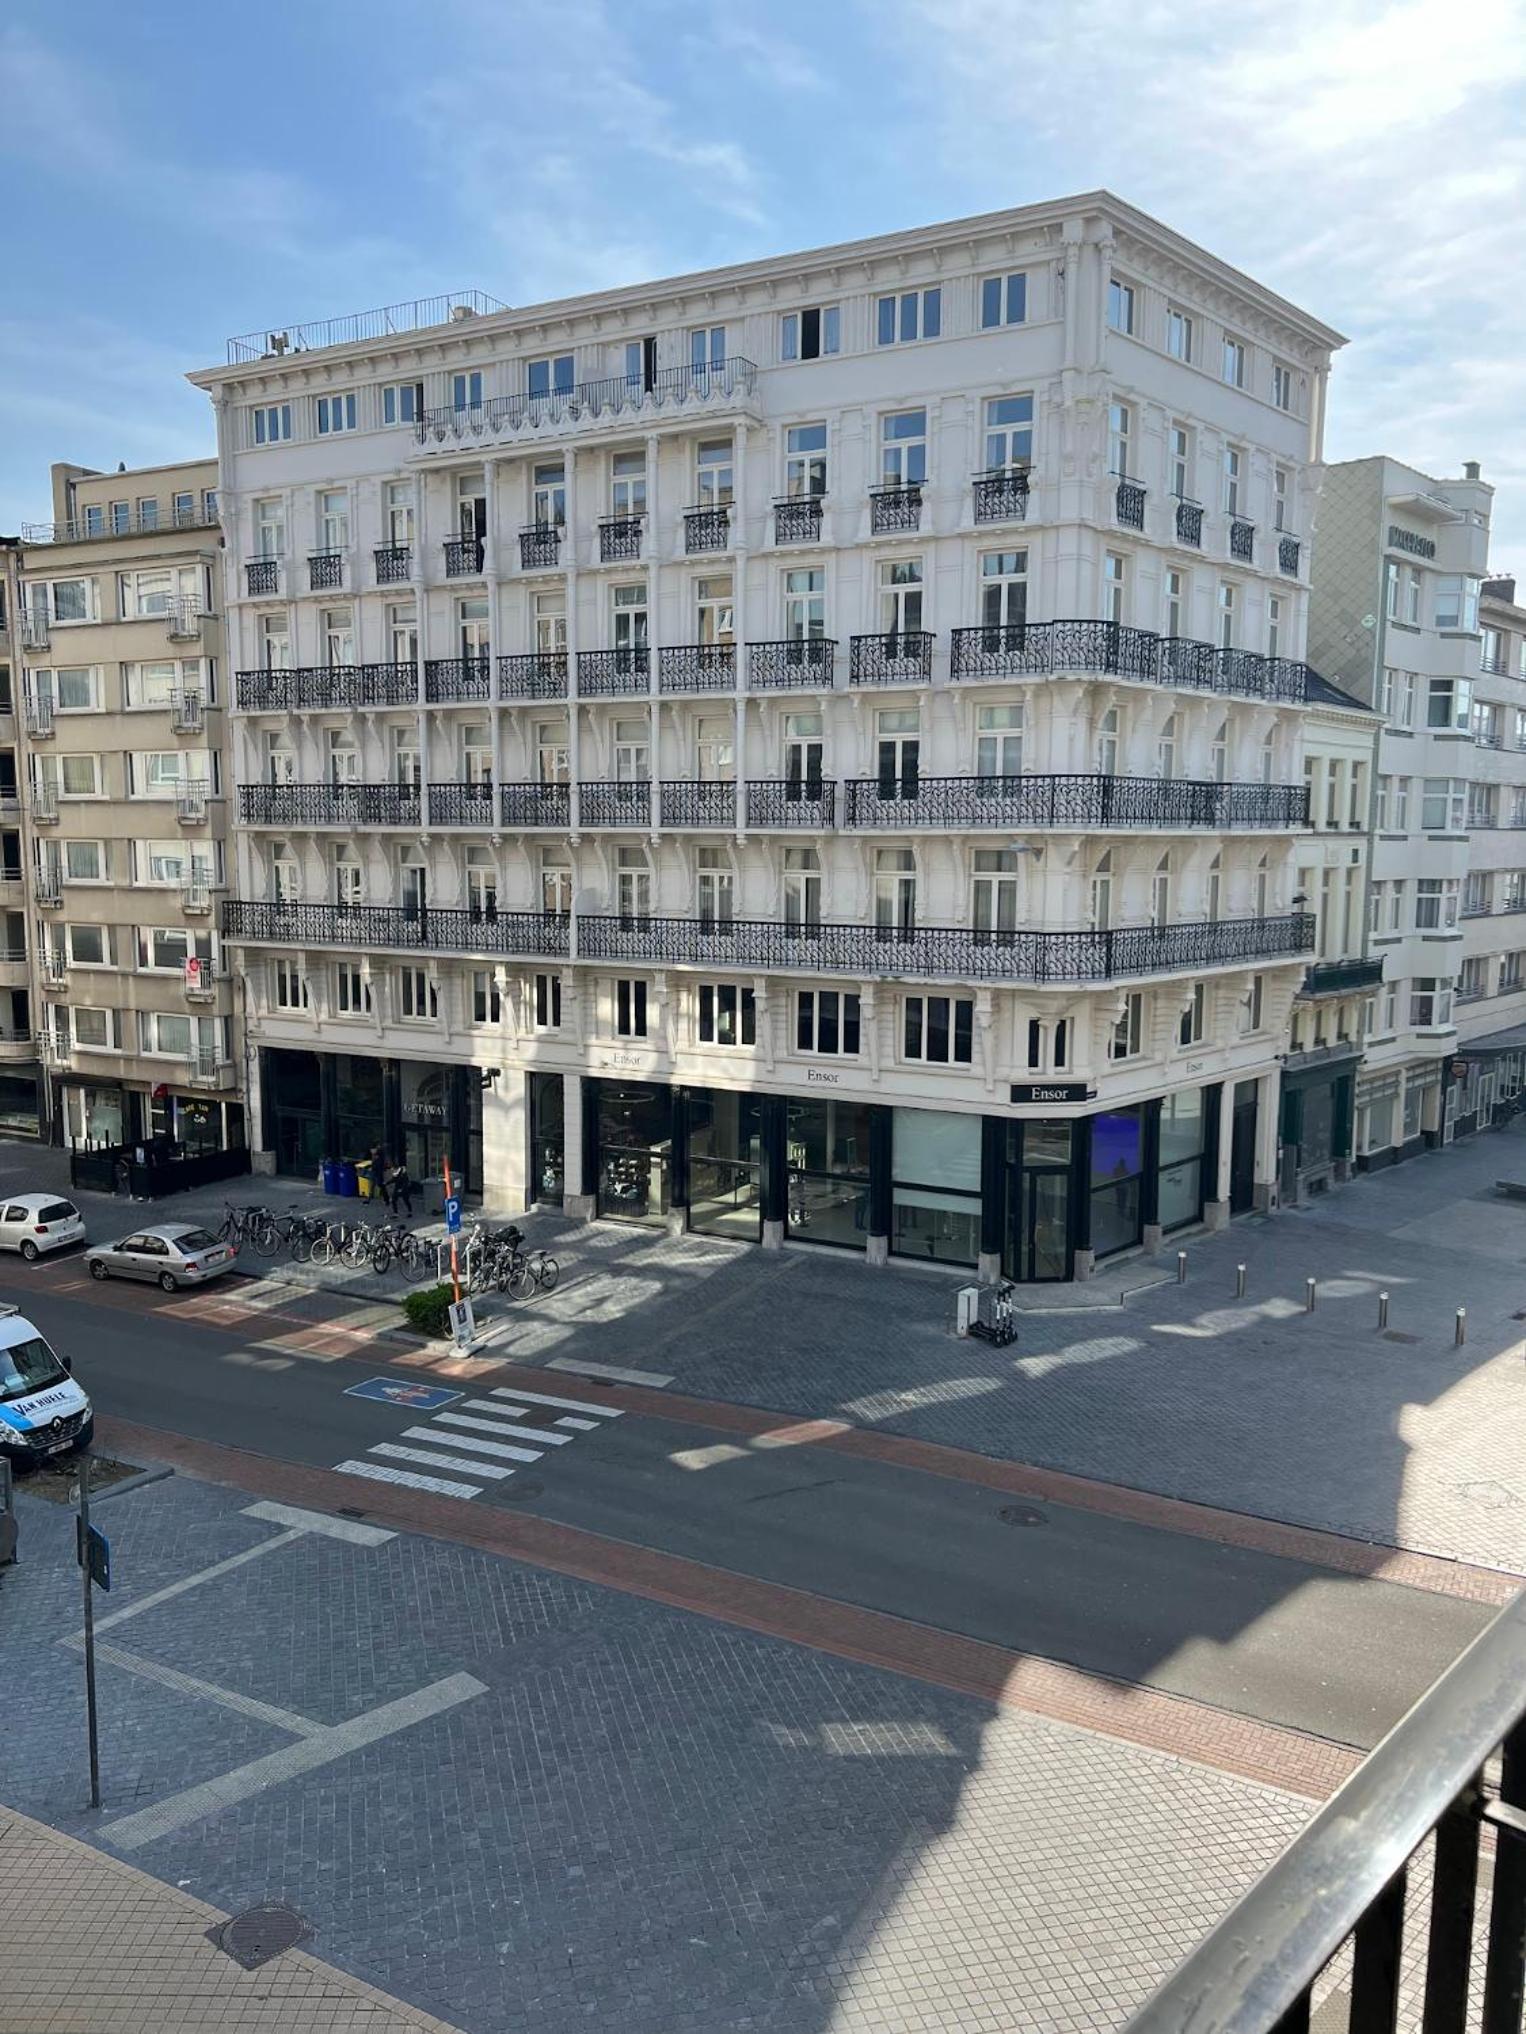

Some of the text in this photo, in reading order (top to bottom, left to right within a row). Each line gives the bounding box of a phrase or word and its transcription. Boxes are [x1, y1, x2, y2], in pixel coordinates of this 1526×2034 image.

[807, 1069, 840, 1083] Ensor
[1031, 1087, 1069, 1100] Ensor
[402, 1103, 447, 1117] GETAWAY
[448, 1200, 459, 1222] P
